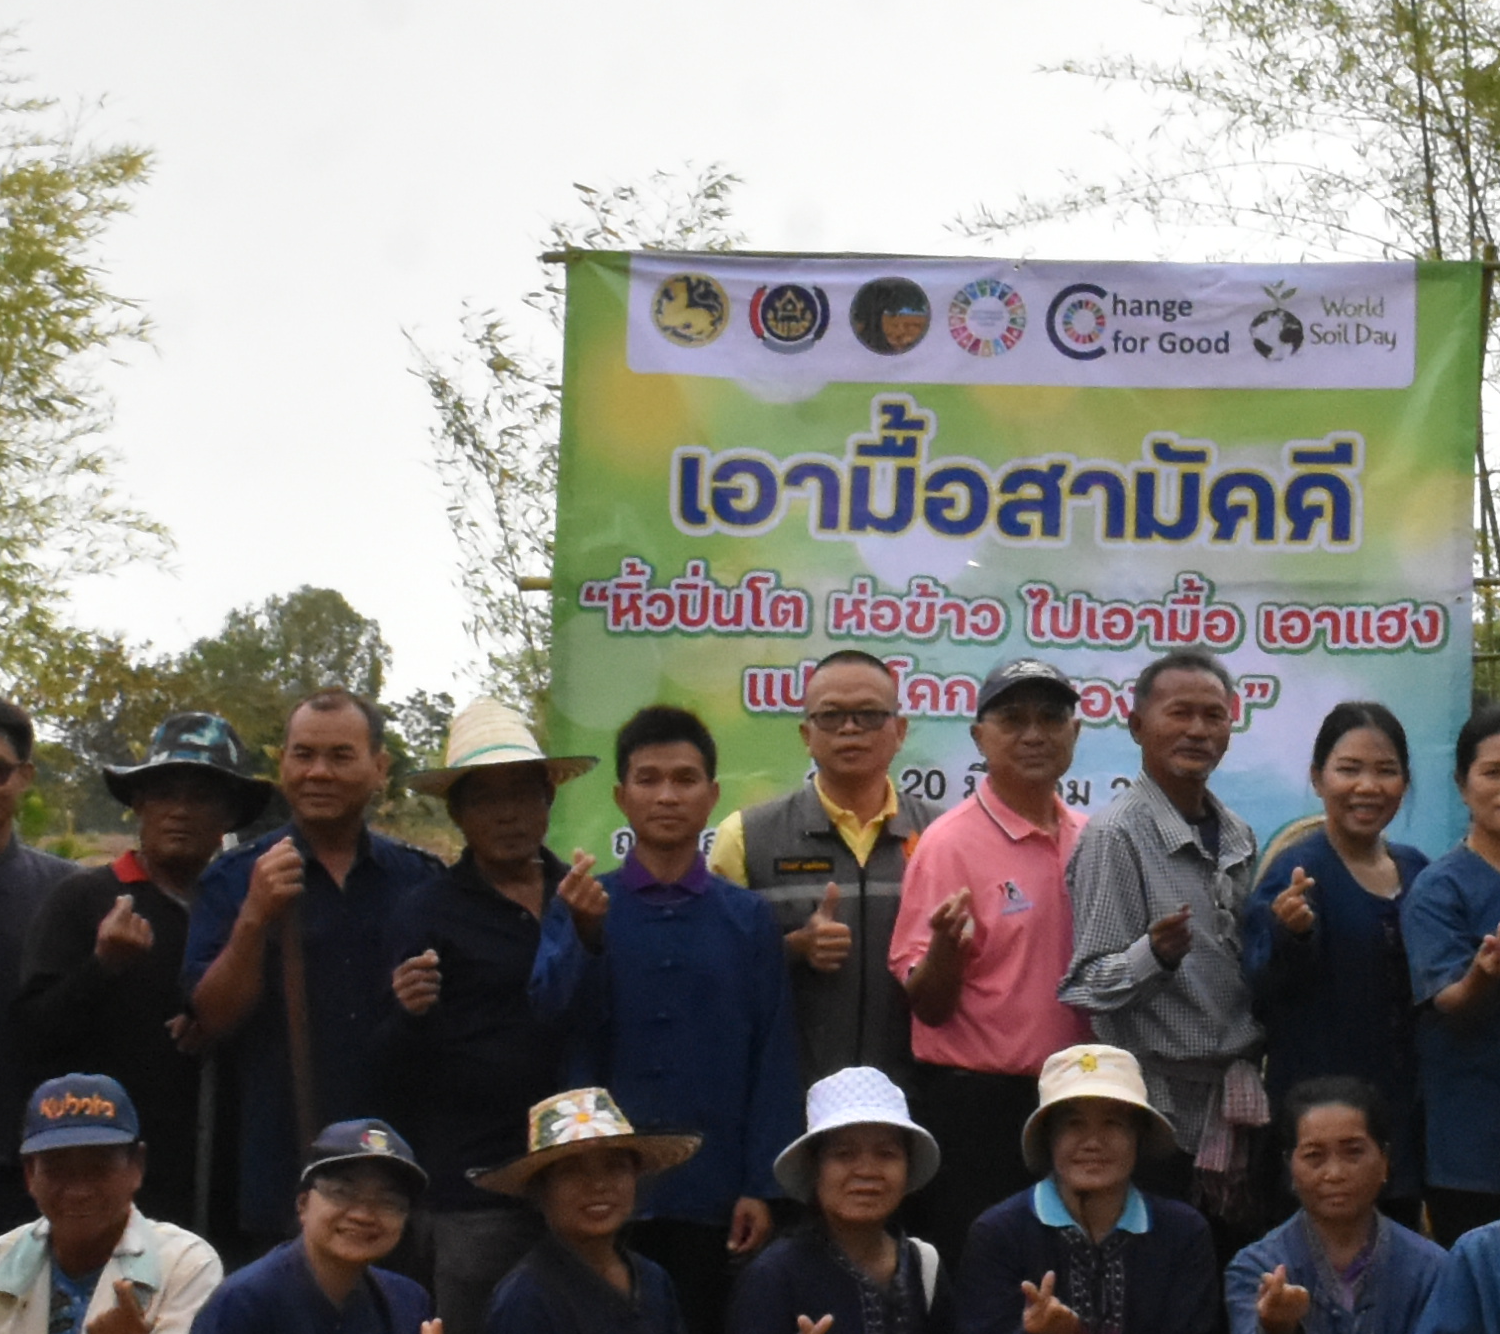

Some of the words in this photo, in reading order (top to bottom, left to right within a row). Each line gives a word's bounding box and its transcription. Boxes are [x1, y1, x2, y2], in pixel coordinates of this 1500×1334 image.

[1320, 296, 1385, 319] World
[1112, 330, 1150, 354] for
[1158, 331, 1230, 355] Good
[1309, 323, 1349, 346] Soil
[1356, 324, 1397, 352] Day
[677, 402, 1357, 546] เอามื้อสามัคคี
[831, 581, 1003, 636] ห่อข้าว
[1024, 576, 1238, 644] ไปเอามื้อ
[1261, 606, 1441, 646] เอาแฮง
